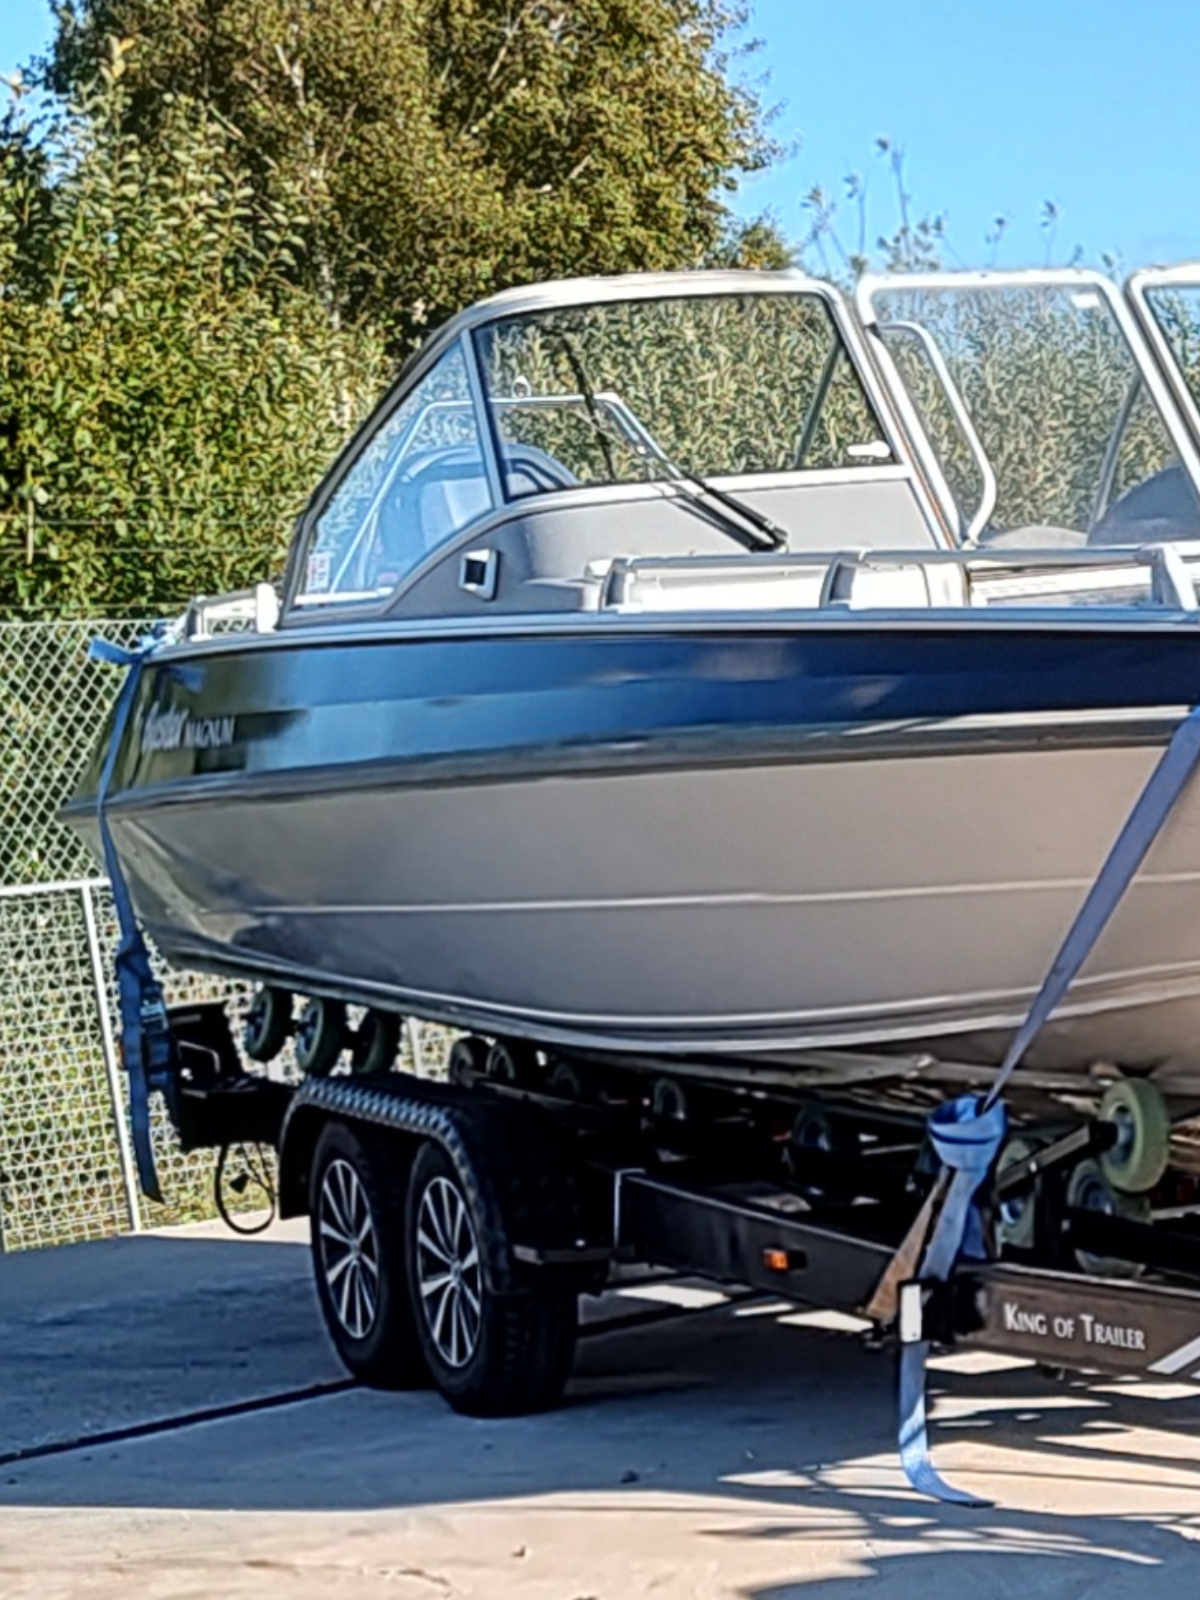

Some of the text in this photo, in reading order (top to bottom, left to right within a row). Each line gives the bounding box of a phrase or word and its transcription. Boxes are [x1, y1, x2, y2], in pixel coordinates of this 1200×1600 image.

[1003, 1302, 1146, 1350] KING OF TRAILER
